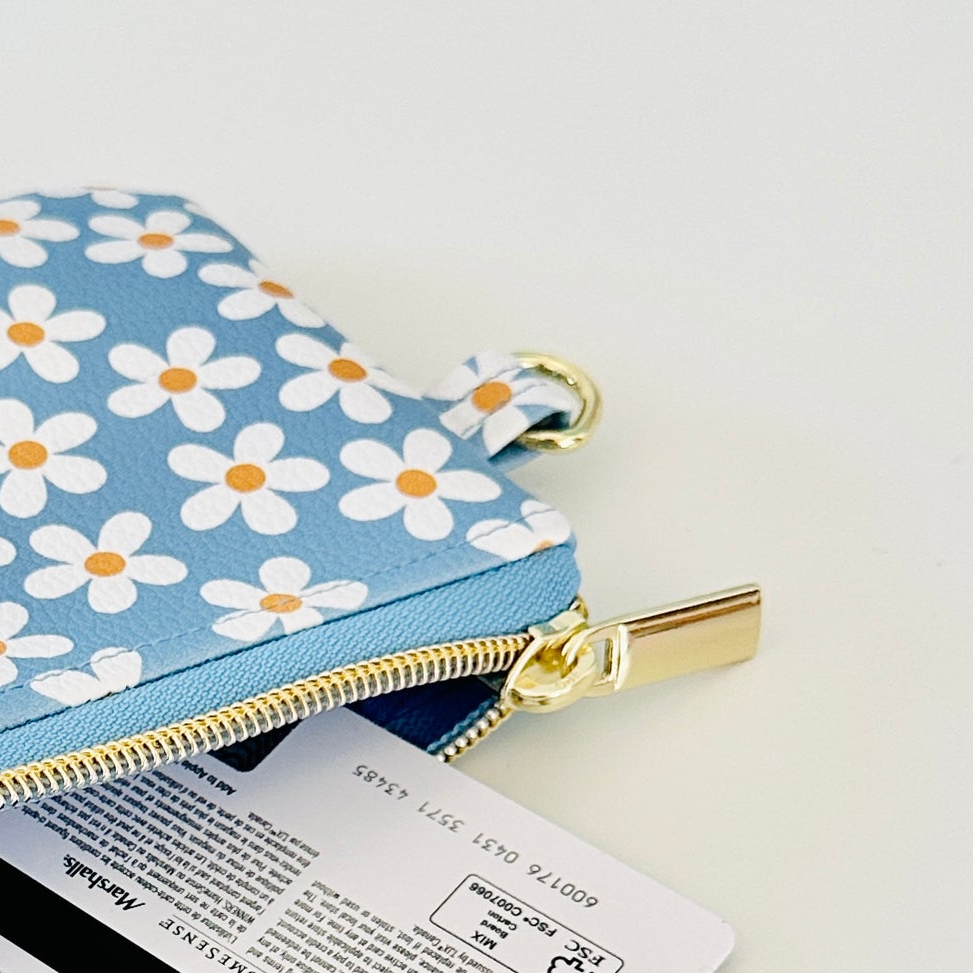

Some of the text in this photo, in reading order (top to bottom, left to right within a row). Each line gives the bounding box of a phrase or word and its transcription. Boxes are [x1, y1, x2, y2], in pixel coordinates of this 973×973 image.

[180, 757, 238, 796] Add to Apple
[352, 764, 599, 908] 600176 0431 3571 43485
[62, 855, 147, 911] Marshalls
[310, 879, 341, 900] without
[302, 889, 318, 904] The
[338, 897, 361, 912] used
[468, 881, 523, 917] C007066
[173, 900, 193, 915] cette
[293, 898, 314, 914] more
[360, 910, 371, 918] or
[190, 910, 202, 921] de
[284, 908, 309, 925] return
[311, 910, 327, 923] For
[337, 911, 359, 928] local
[486, 909, 518, 932] Carton
[306, 921, 328, 937] store
[356, 923, 377, 936] your
[370, 915, 396, 933] stolen
[479, 919, 510, 940] Board
[256, 935, 273, 949] any
[263, 927, 303, 953] redeemed
[343, 928, 360, 942] any
[356, 937, 369, 947] at
[373, 932, 393, 947] visit
[469, 929, 498, 951] MIX
[245, 946, 264, 959] and
[268, 944, 281, 954] at
[304, 936, 329, 953] credit
[326, 933, 364, 960] applicable
[326, 948, 335, 956] a
[364, 942, 386, 957] card
[391, 943, 419, 962] please
[411, 941, 423, 951] if
[300, 948, 313, 961] be
[330, 951, 349, 965] pay
[362, 955, 374, 967] to
[419, 946, 456, 970] replaced
[456, 951, 470, 965] by
[563, 938, 607, 968] FSC
[262, 955, 286, 973] terms
[309, 954, 338, 973] cannot
[344, 960, 356, 971] to
[383, 953, 409, 971] active
